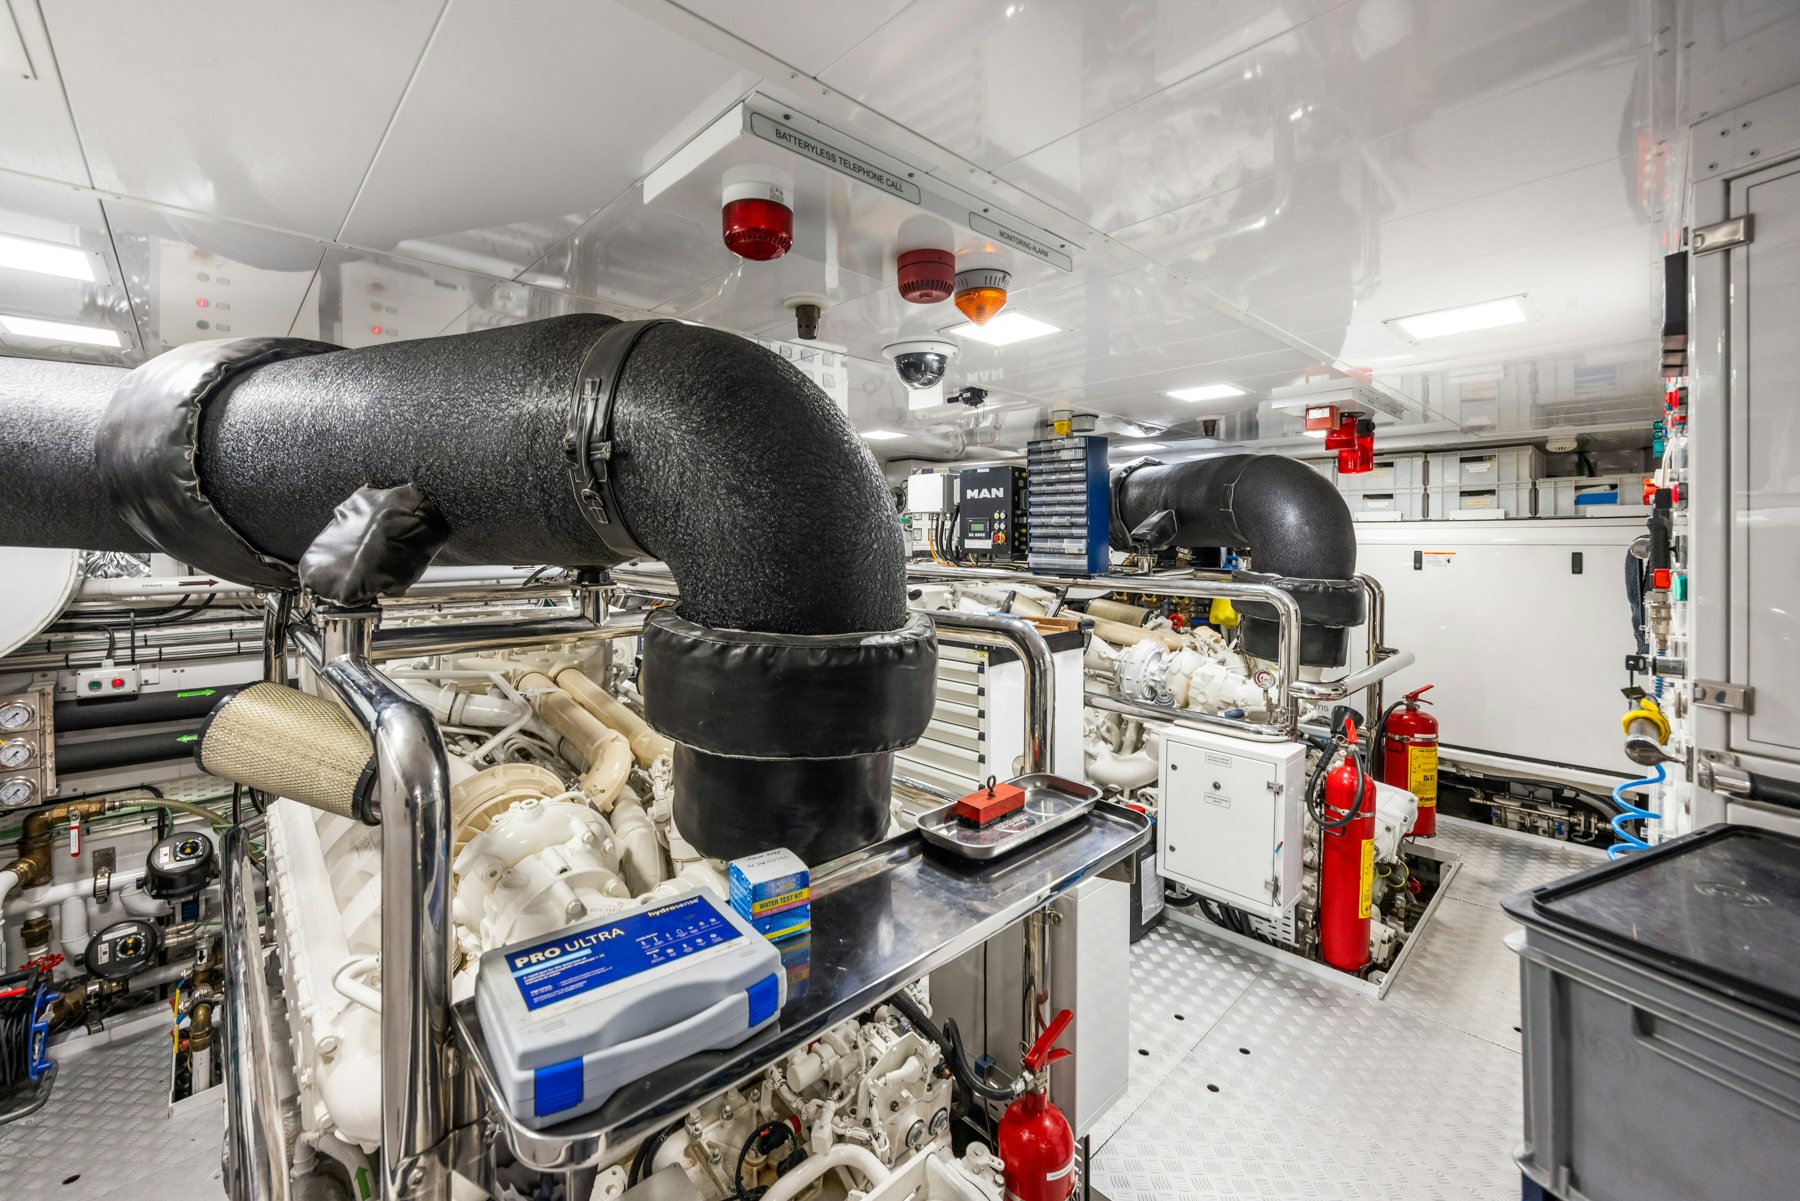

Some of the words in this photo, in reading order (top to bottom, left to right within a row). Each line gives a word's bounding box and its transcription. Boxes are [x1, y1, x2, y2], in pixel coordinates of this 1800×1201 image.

[775, 128, 837, 163] BATTERYLESS
[838, 156, 885, 184] TELEPHONE
[885, 178, 904, 193] CALL
[999, 230, 1032, 250] MONITORING
[1032, 244, 1049, 258] ALARM
[966, 487, 1004, 499] MAN
[647, 898, 700, 917] hydrosense
[759, 899, 779, 910] WATER
[780, 895, 794, 904] TEST
[795, 892, 804, 900] KIT
[514, 947, 562, 968] PRO
[565, 928, 625, 952] ULTRA
